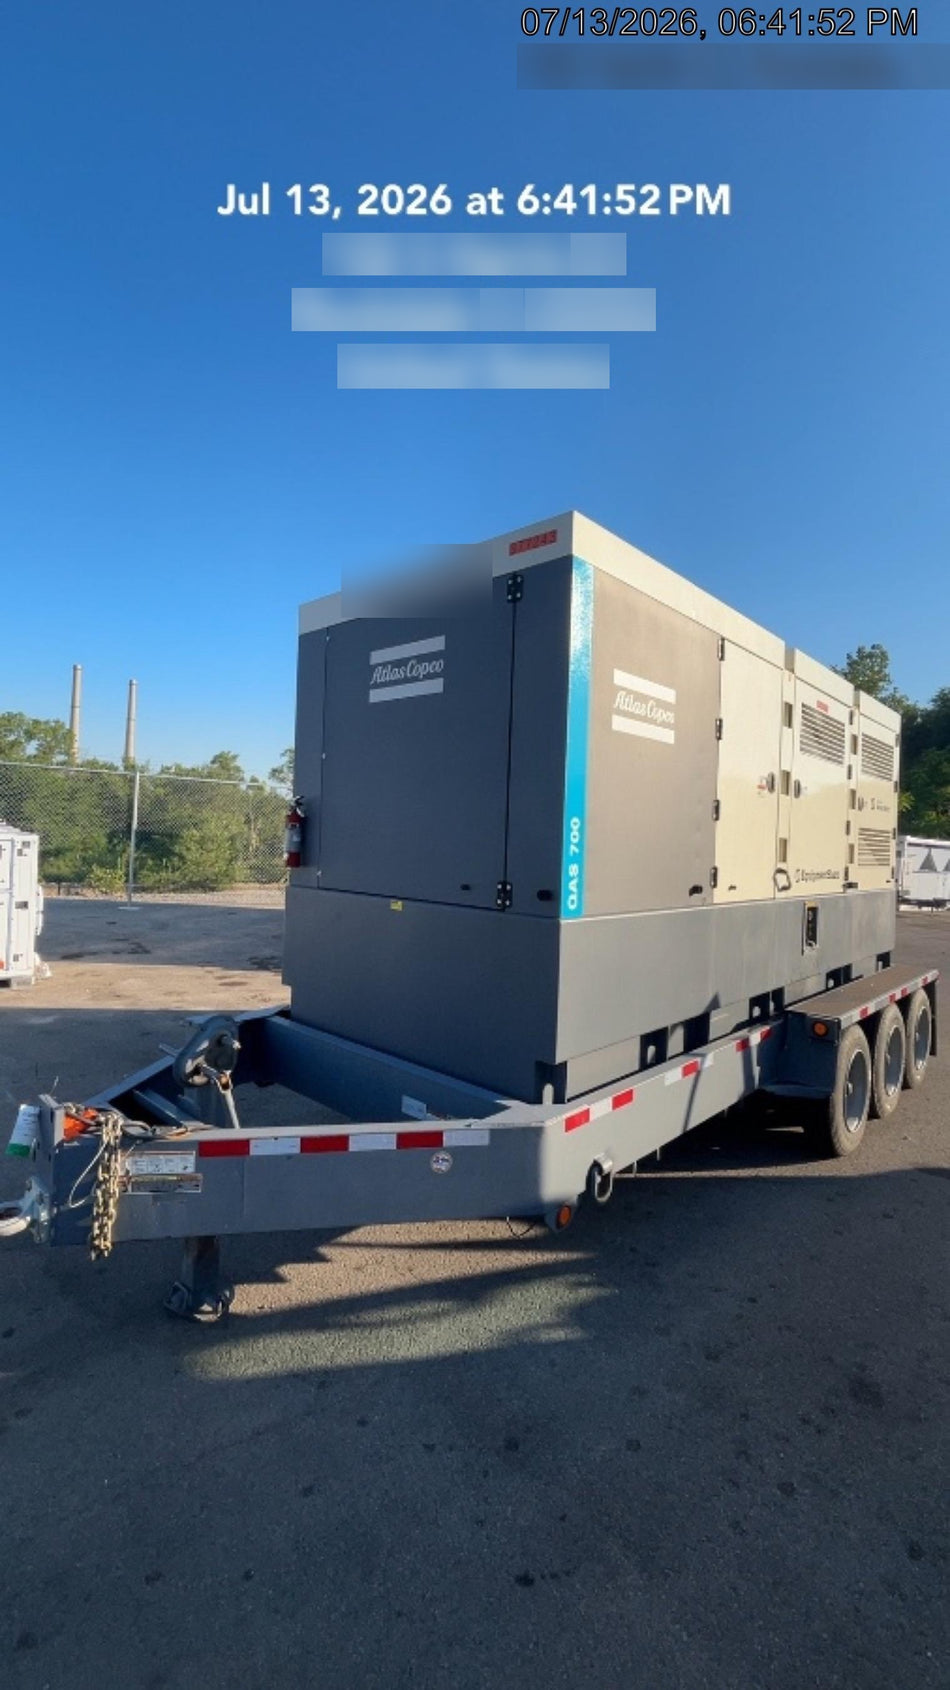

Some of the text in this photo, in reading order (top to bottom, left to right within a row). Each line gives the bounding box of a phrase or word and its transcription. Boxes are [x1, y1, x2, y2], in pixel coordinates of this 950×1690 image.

[369, 659, 444, 685] Atlas Copco
[614, 690, 646, 717] Atlas
[567, 816, 581, 911] QAS 700
